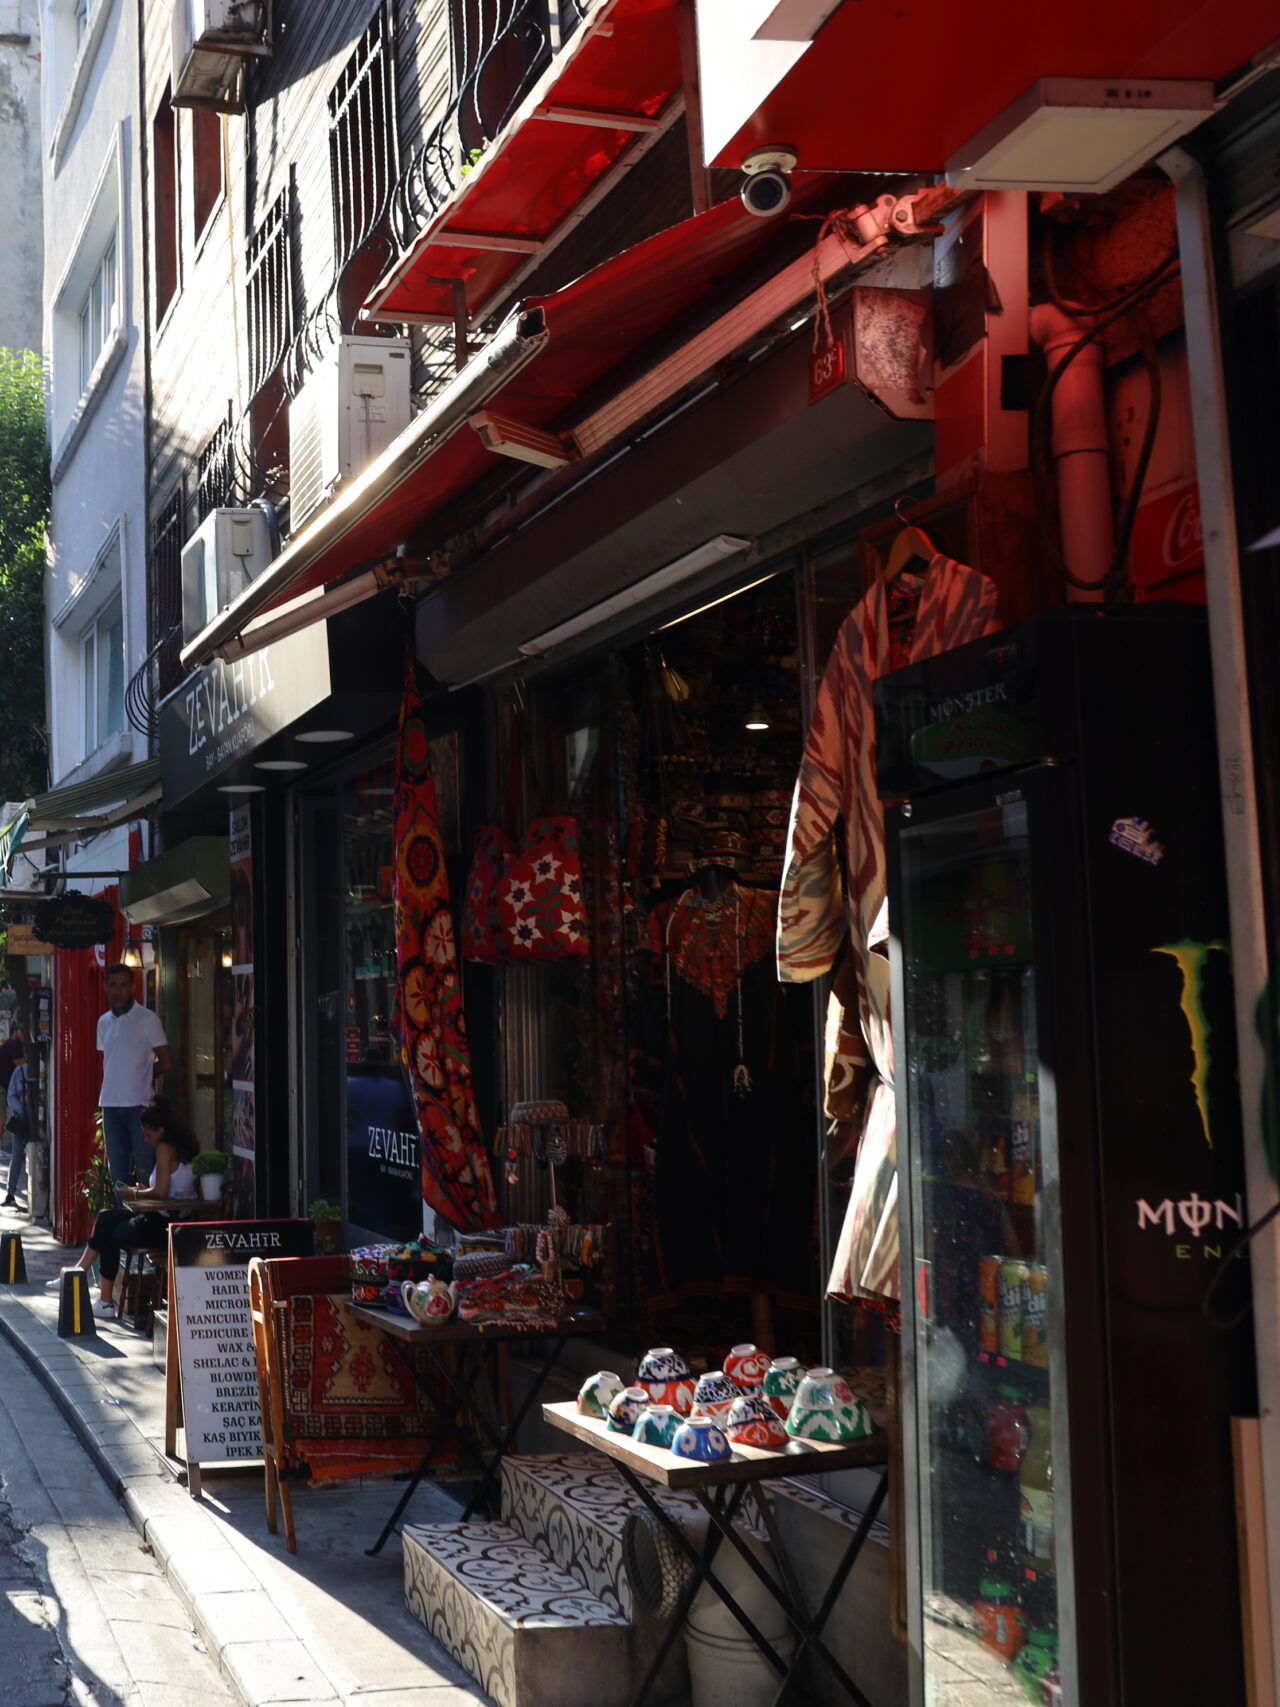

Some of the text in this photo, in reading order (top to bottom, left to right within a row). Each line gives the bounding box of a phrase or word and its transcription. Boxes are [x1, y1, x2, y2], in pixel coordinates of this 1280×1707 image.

[368, 1126, 420, 1169] ZEVAHİ
[212, 1285, 240, 1296] HAIR
[186, 1313, 248, 1325] MANICURE
[190, 1328, 249, 1340] PEDICURE
[217, 1342, 244, 1354] WAX
[193, 1357, 250, 1369] SHELAC &
[203, 1431, 261, 1445] KAŞ BIYIK
[226, 1444, 253, 1457] İPEK
